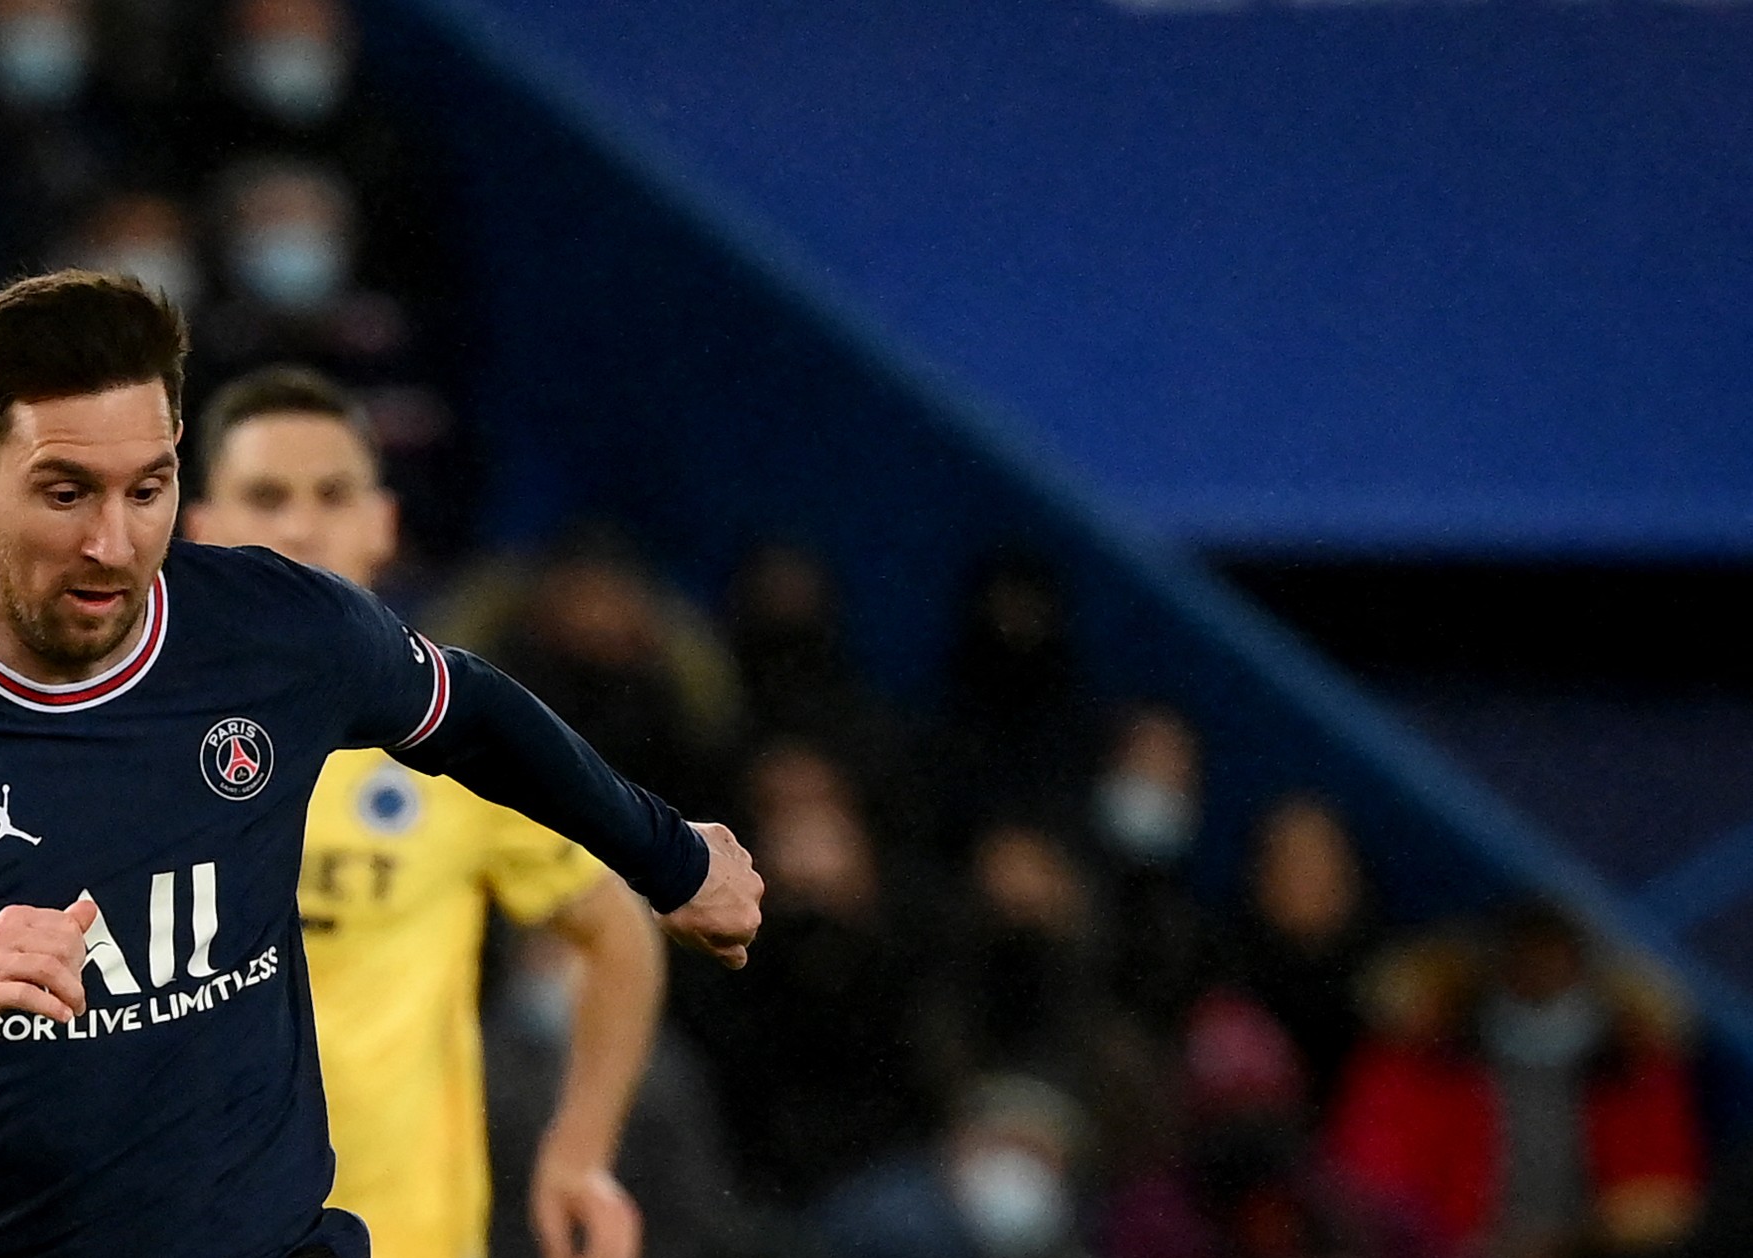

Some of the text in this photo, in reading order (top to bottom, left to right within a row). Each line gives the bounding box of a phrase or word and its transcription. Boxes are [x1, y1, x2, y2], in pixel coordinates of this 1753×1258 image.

[208, 722, 256, 747] PARIS
[68, 1003, 142, 1040] LIVE
[150, 946, 279, 1024] LIMITLESS
